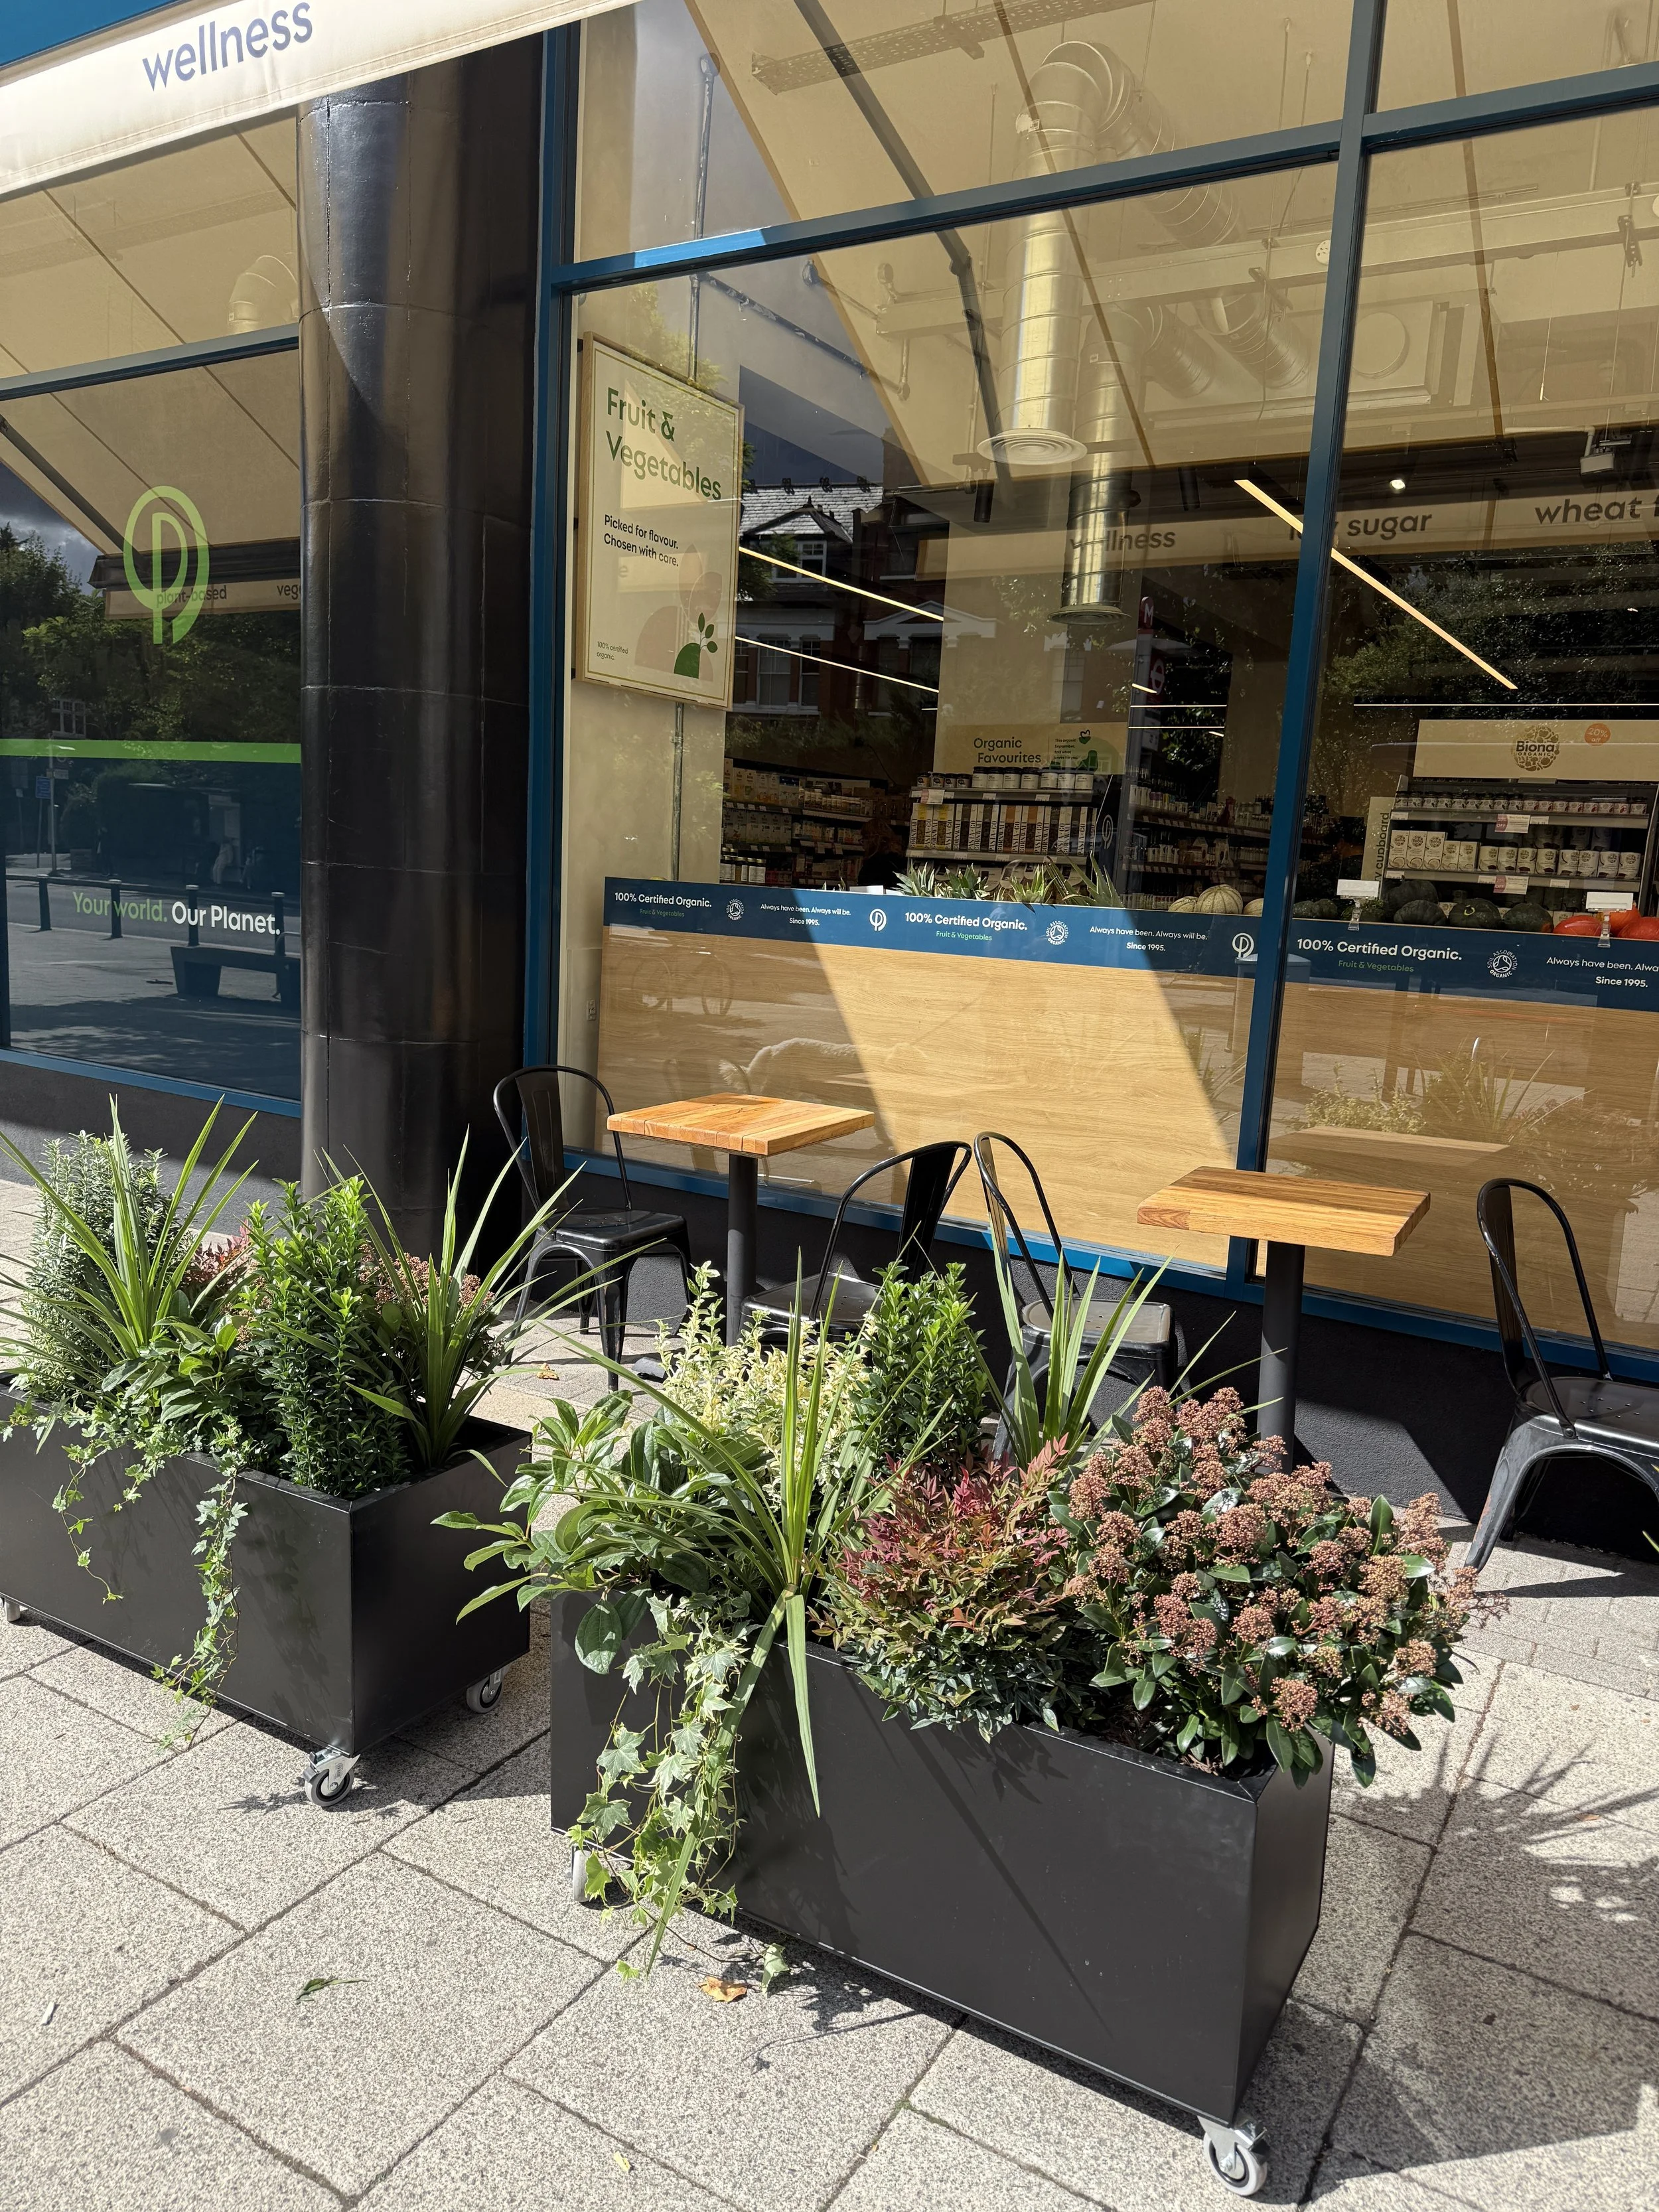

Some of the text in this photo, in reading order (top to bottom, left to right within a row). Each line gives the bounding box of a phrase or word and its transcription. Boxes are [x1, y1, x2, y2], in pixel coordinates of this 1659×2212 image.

[142, 2, 313, 92] wellness
[607, 387, 675, 442] Fruit &
[605, 430, 721, 500] Vegetables
[1535, 496, 1642, 525] wheat
[605, 514, 678, 550] Picked for flavour.
[1347, 514, 1432, 540] sugar
[604, 533, 679, 567] Chosen with care.
[157, 585, 227, 608] plant-based
[277, 585, 301, 599] veg
[1143, 603, 1154, 627] M
[1588, 727, 1607, 738] 20%
[974, 737, 1022, 751] Organic
[1516, 741, 1555, 752] Biona
[977, 751, 1041, 763] Favourites
[1376, 812, 1390, 869] cupboard
[614, 893, 712, 908] 100% Certified Organic.
[73, 892, 281, 935] Your world. Our Planet.
[905, 912, 1028, 931] 100% Certified Organic.
[957, 932, 992, 941] Vegetables
[1090, 926, 1115, 936] Always
[1155, 930, 1181, 940] Always
[1126, 942, 1147, 950] Since
[1297, 938, 1463, 961] 100% Certified Organic.
[1338, 960, 1415, 973] Fruit & Vegetables
[1492, 950, 1518, 971] ASSOCIATION
[1546, 956, 1659, 972] Always have been. Alwa
[1489, 969, 1513, 978] ORGANIC
[1595, 976, 1648, 988] Since 1995.
